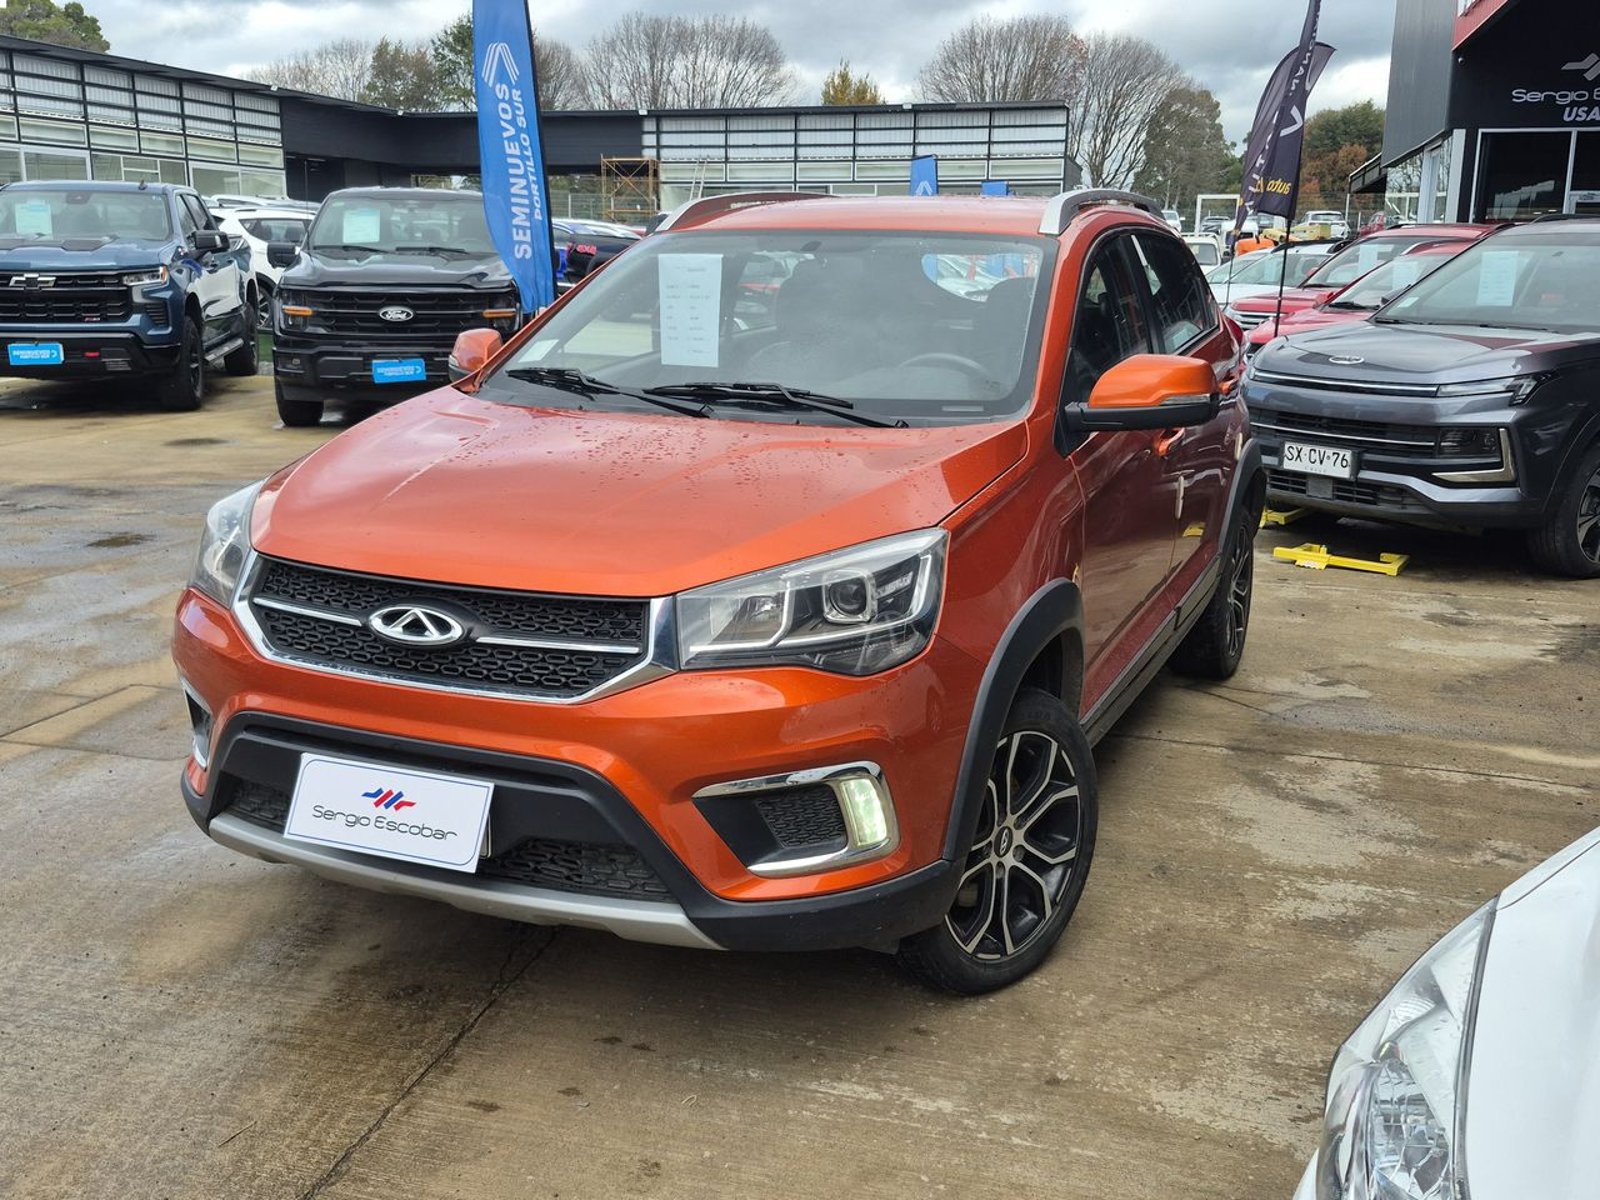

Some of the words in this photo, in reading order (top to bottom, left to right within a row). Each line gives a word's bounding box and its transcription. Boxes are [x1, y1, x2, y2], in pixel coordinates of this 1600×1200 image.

[511, 89, 527, 129] SUR
[1511, 88, 1589, 105] Sergio
[495, 83, 532, 259] SEMINUEVOS
[520, 133, 543, 221] PORTILLO
[312, 805, 371, 828] Sergio
[374, 815, 458, 841] Escobar
